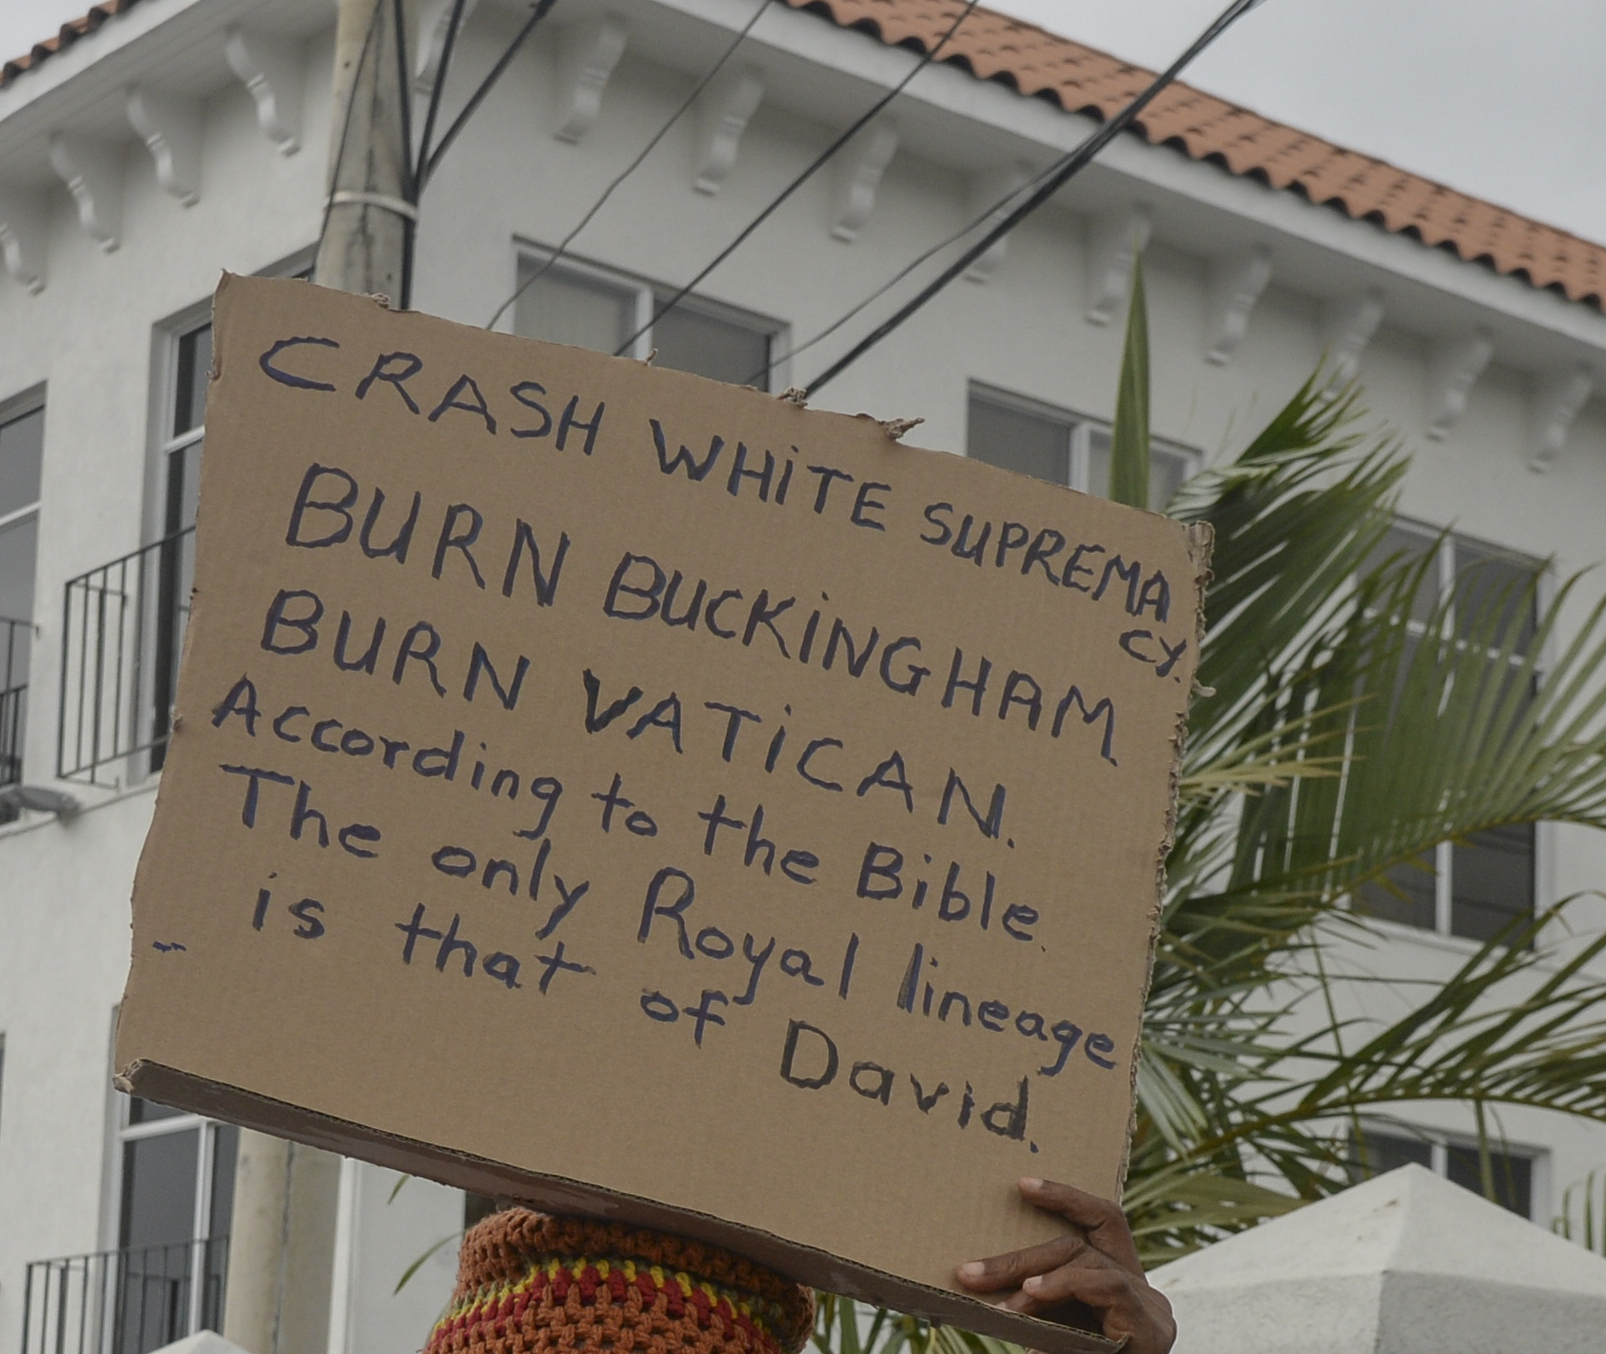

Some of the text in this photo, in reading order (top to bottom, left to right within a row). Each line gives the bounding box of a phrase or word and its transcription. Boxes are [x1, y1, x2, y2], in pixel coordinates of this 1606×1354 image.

[259, 337, 605, 456] CRASH
[920, 502, 1171, 624] SUPREMA
[287, 464, 570, 606] BURN
[261, 590, 530, 710] BURN
[212, 677, 563, 840] According
[594, 776, 657, 836] to
[699, 796, 819, 884] the
[222, 764, 1115, 1076] The only Royal lineage
[252, 872, 326, 940] is
[395, 902, 596, 995] that
[641, 991, 728, 1044] of
